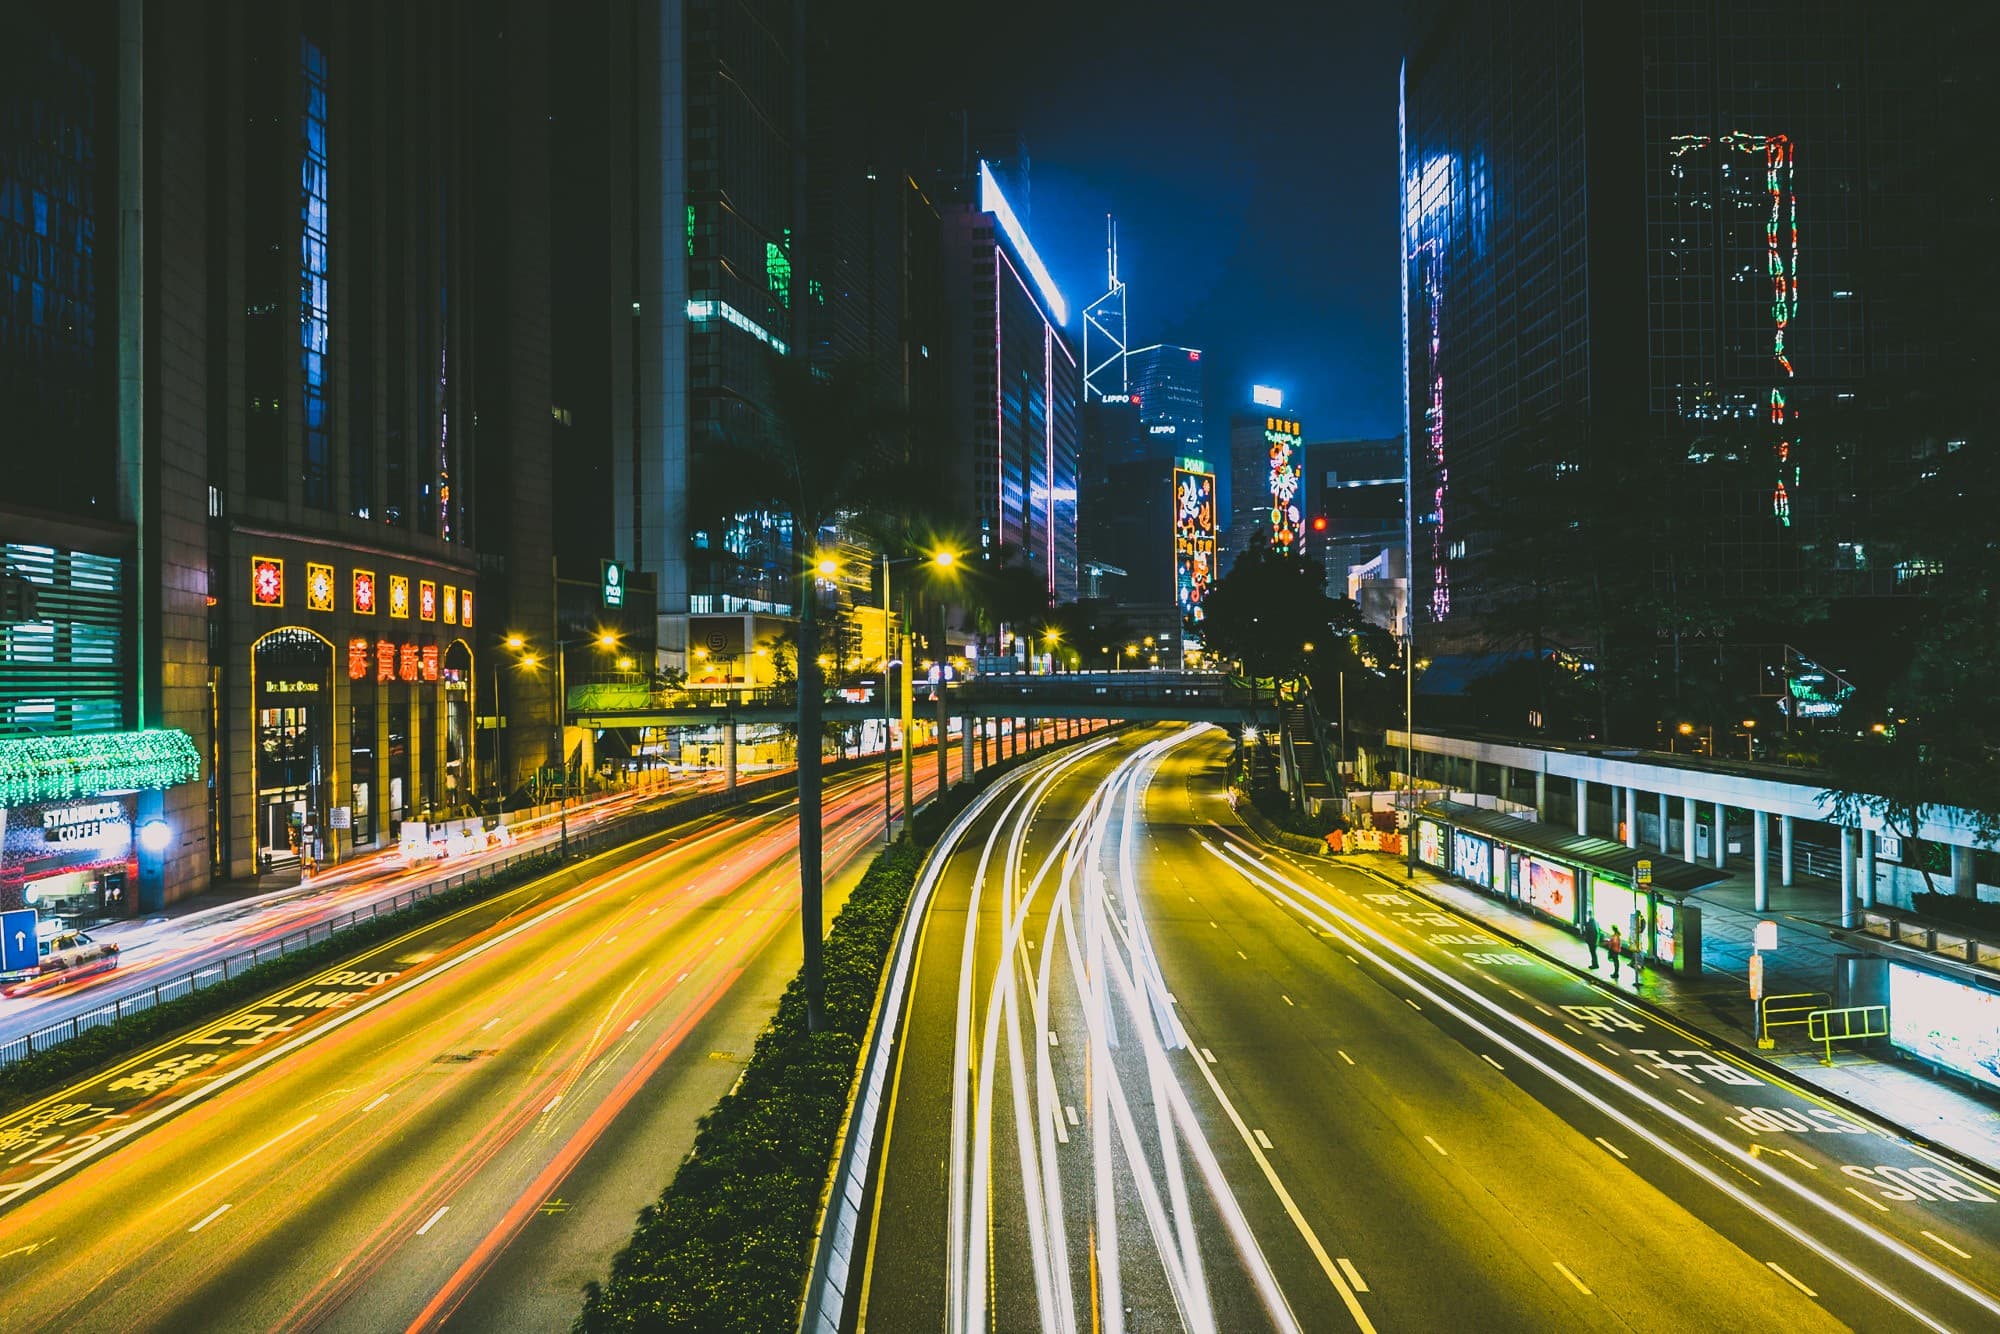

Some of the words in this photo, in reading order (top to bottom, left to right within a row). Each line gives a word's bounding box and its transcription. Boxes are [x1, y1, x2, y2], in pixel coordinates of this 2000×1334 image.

[1102, 395, 1130, 403] LIPPO
[1149, 426, 1176, 434] LIPPO
[43, 801, 120, 829] STARBUCKS
[1391, 912, 1460, 927] 巴士
[1427, 933, 1500, 946] STOP
[1462, 952, 1536, 966] BUS
[313, 971, 402, 986] BUS
[263, 991, 370, 1008] LANE
[1559, 1004, 1646, 1033] 站
[184, 1014, 305, 1045] 巴士
[1629, 1048, 1766, 1086] 巴士
[1731, 1104, 1870, 1134] STOP
[1840, 1164, 1998, 1204] BUS
